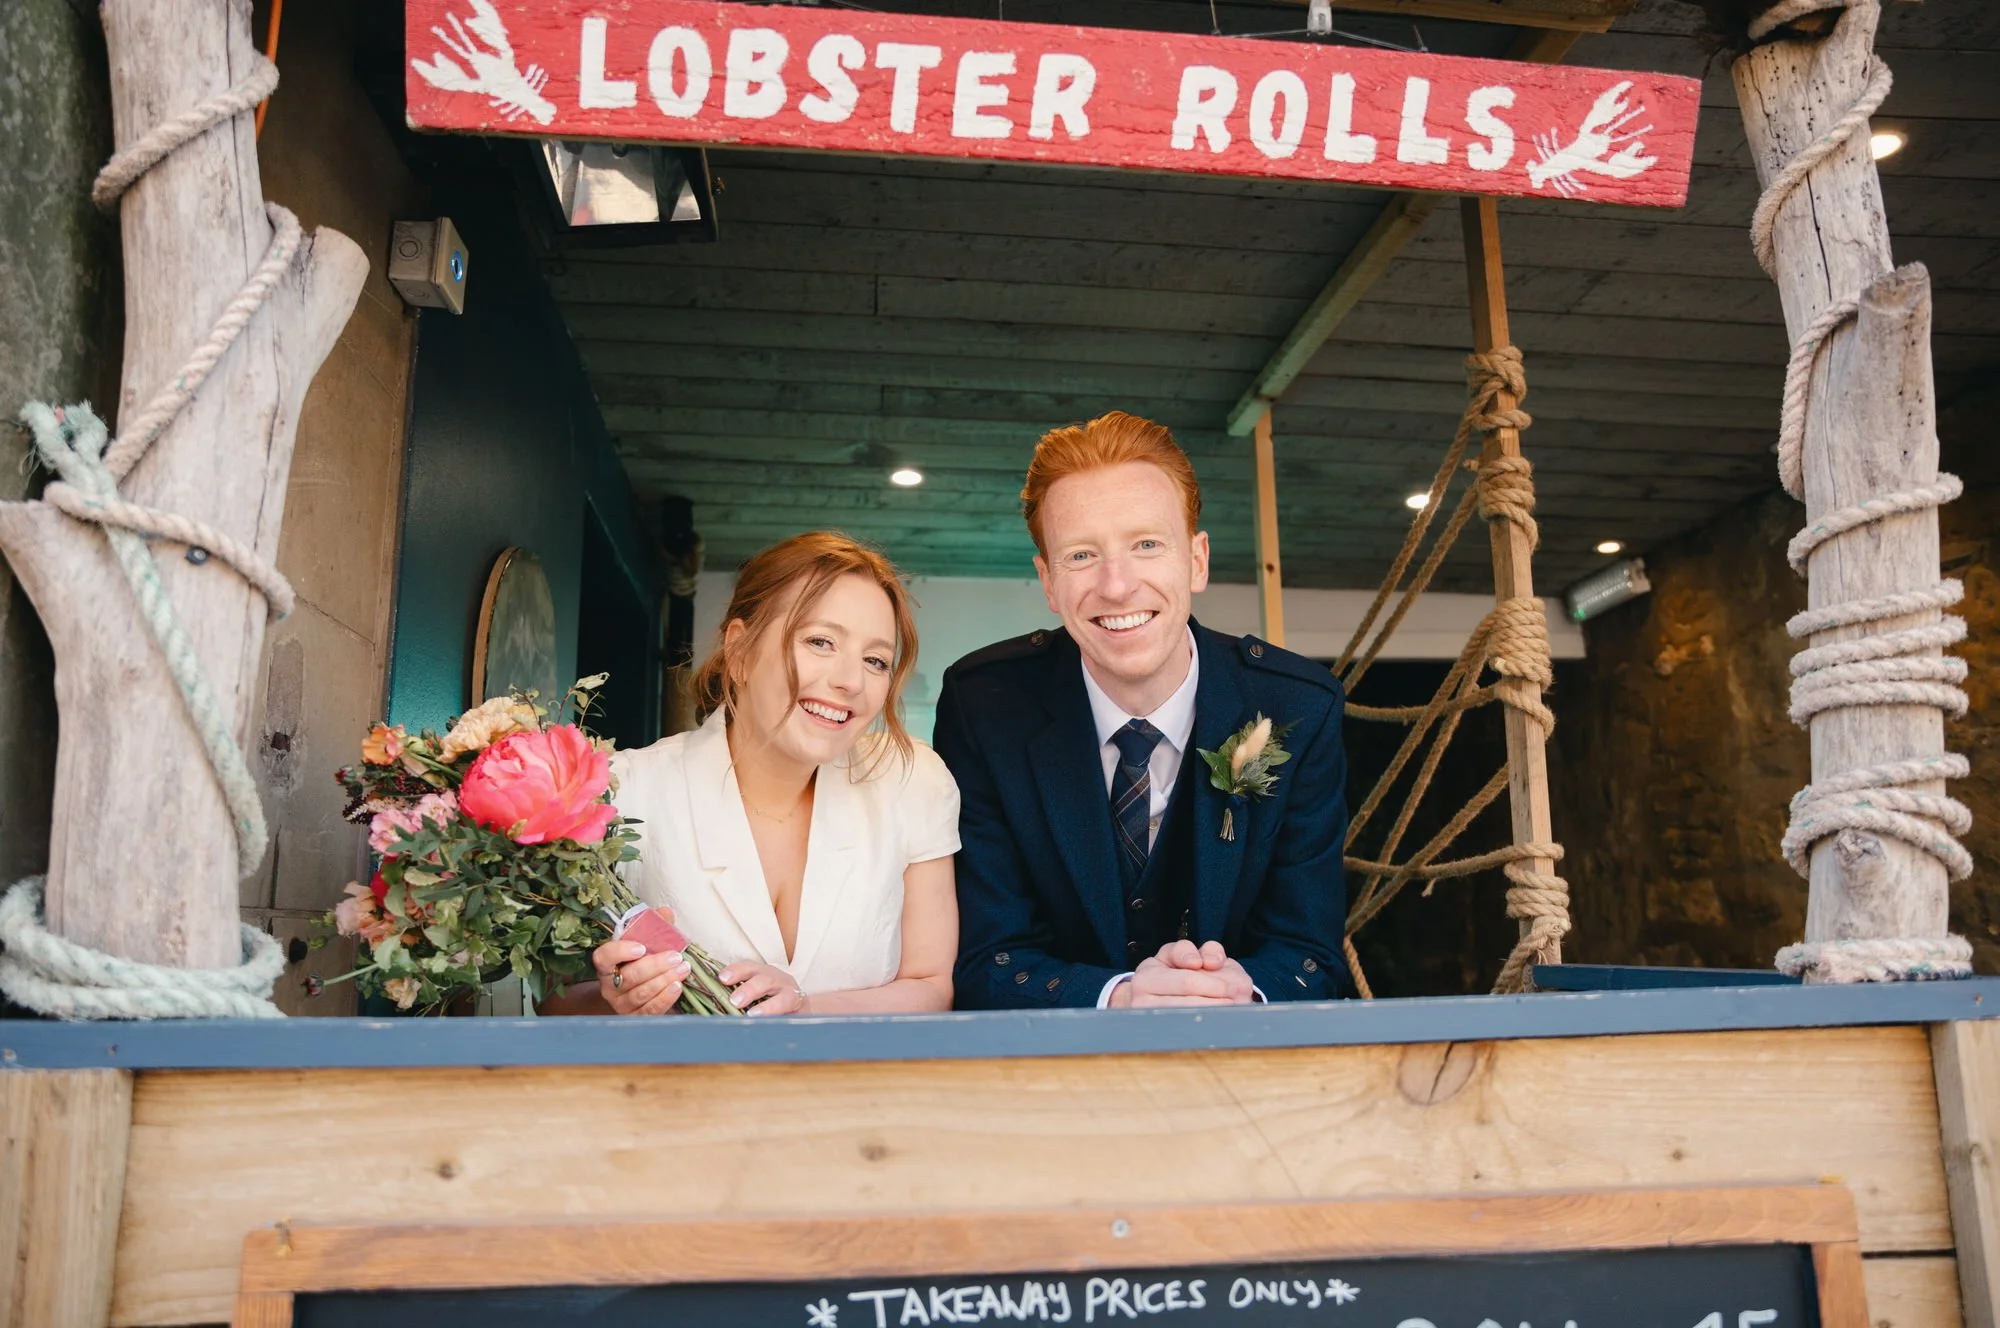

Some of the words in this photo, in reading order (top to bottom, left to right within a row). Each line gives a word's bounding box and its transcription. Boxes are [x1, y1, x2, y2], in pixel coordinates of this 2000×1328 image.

[578, 16, 1097, 141] LOBSTER
[1171, 64, 1517, 172] ROLLS
[847, 1280, 1073, 1328] TAKEAWAY
[1085, 1277, 1207, 1323] PRICES
